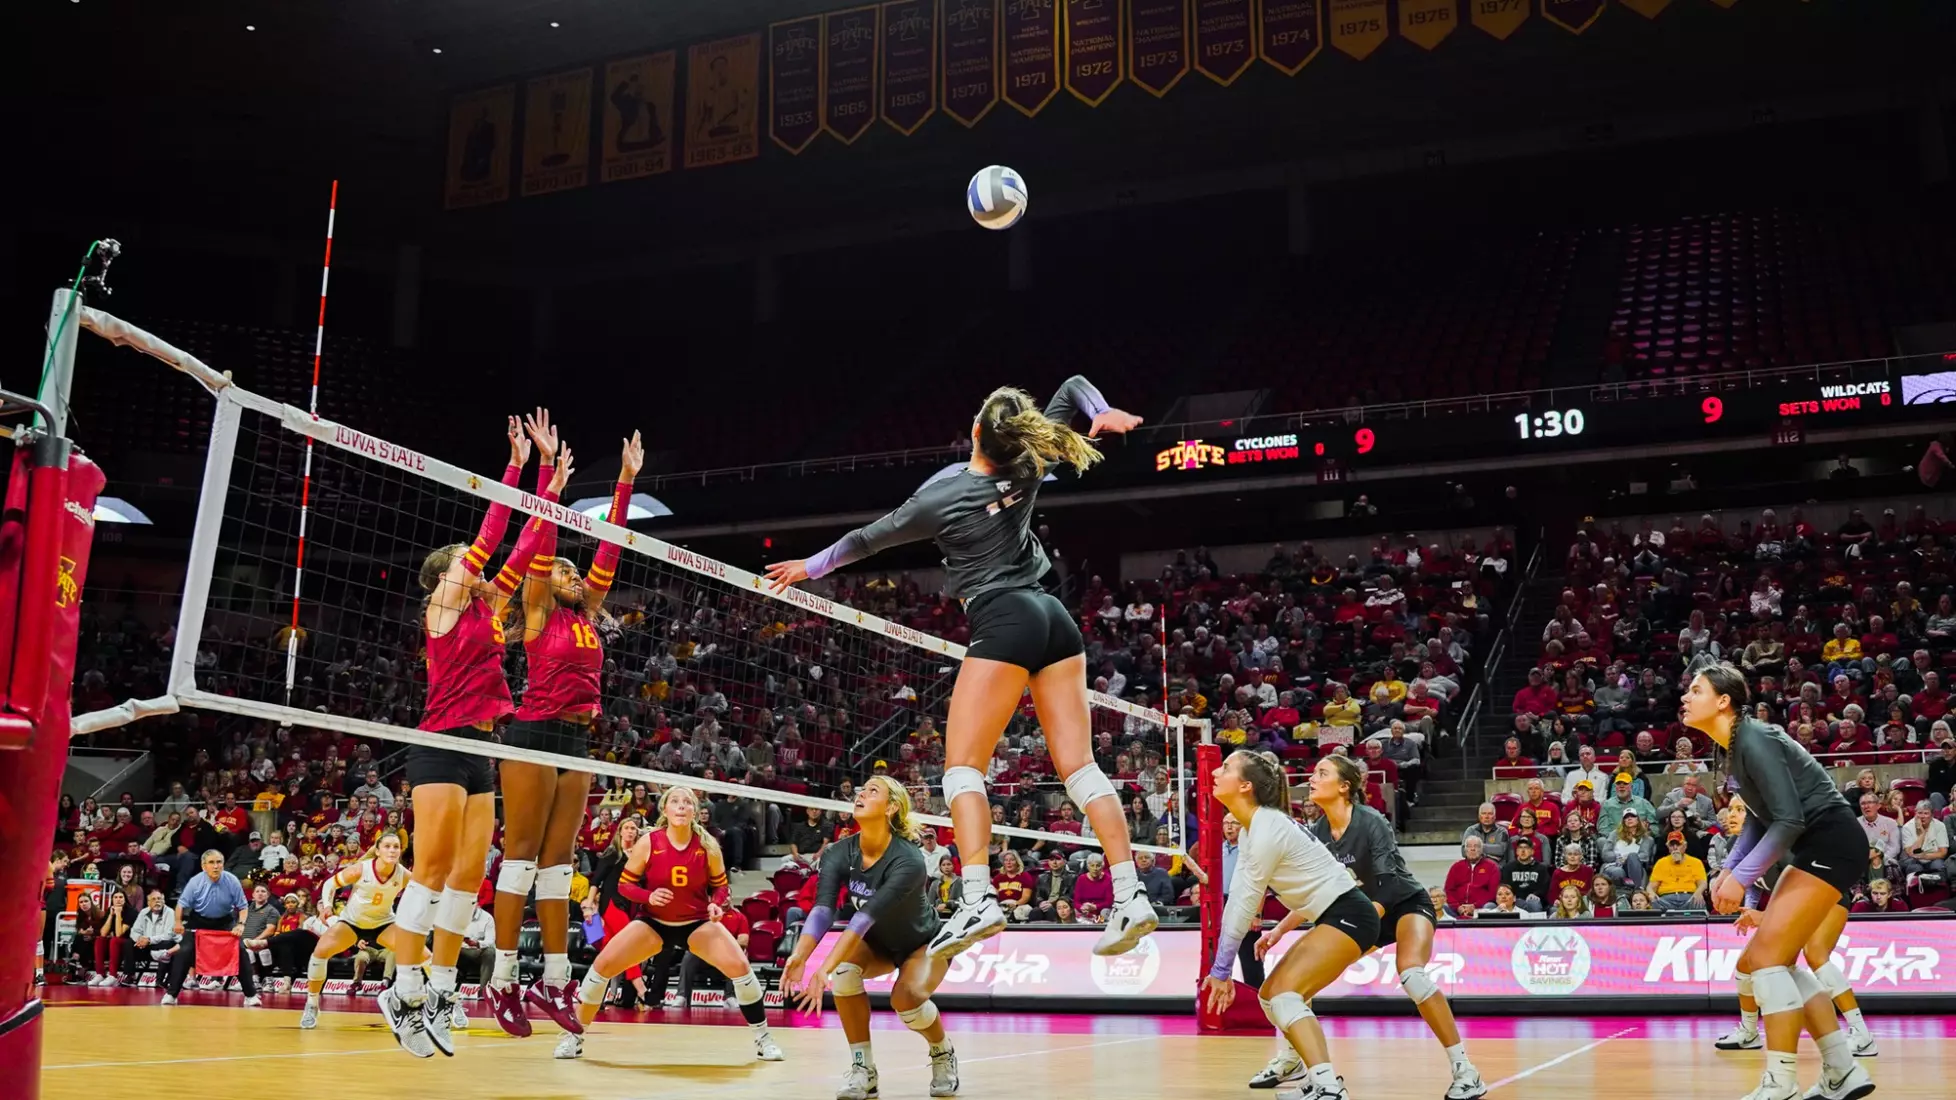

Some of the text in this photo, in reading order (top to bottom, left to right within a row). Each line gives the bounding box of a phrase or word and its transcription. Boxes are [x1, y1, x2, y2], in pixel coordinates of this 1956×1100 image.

[948, 6, 992, 26] STATE
[1407, 8, 1450, 25] 1976
[1339, 19, 1380, 36] 1975
[1271, 28, 1311, 46] 1974
[1205, 39, 1245, 57] 1973
[1139, 50, 1179, 68] 1973
[1076, 60, 1113, 78] 1972
[1015, 71, 1046, 88] 1971
[891, 90, 926, 107] 1969
[952, 81, 988, 100] 1970
[780, 110, 813, 127] 1933
[1820, 381, 1891, 398] WILDCATS
[1701, 397, 1723, 424] 9
[1779, 400, 1820, 416] SETS
[1822, 396, 1861, 412] WON
[1514, 408, 1585, 439] 1:30
[1234, 434, 1298, 451] CYCLONES
[1354, 428, 1376, 454] 9
[1777, 431, 1800, 443] 112
[335, 426, 426, 472] IOWA STATE
[1156, 444, 1226, 472] STATE
[1228, 450, 1263, 464] SETS
[1265, 446, 1299, 460] WON
[520, 492, 593, 532] IOWA STATE
[667, 544, 726, 579] IOWA STATE
[786, 586, 835, 615] IOWA STATE
[571, 622, 599, 649] 18
[884, 620, 924, 646] IOWA STATE
[670, 865, 689, 888] 6
[371, 892, 383, 906] 8
[1109, 965, 1141, 976] HOT
[1534, 963, 1570, 975] HOT
[1530, 977, 1572, 985] SAVINGS
